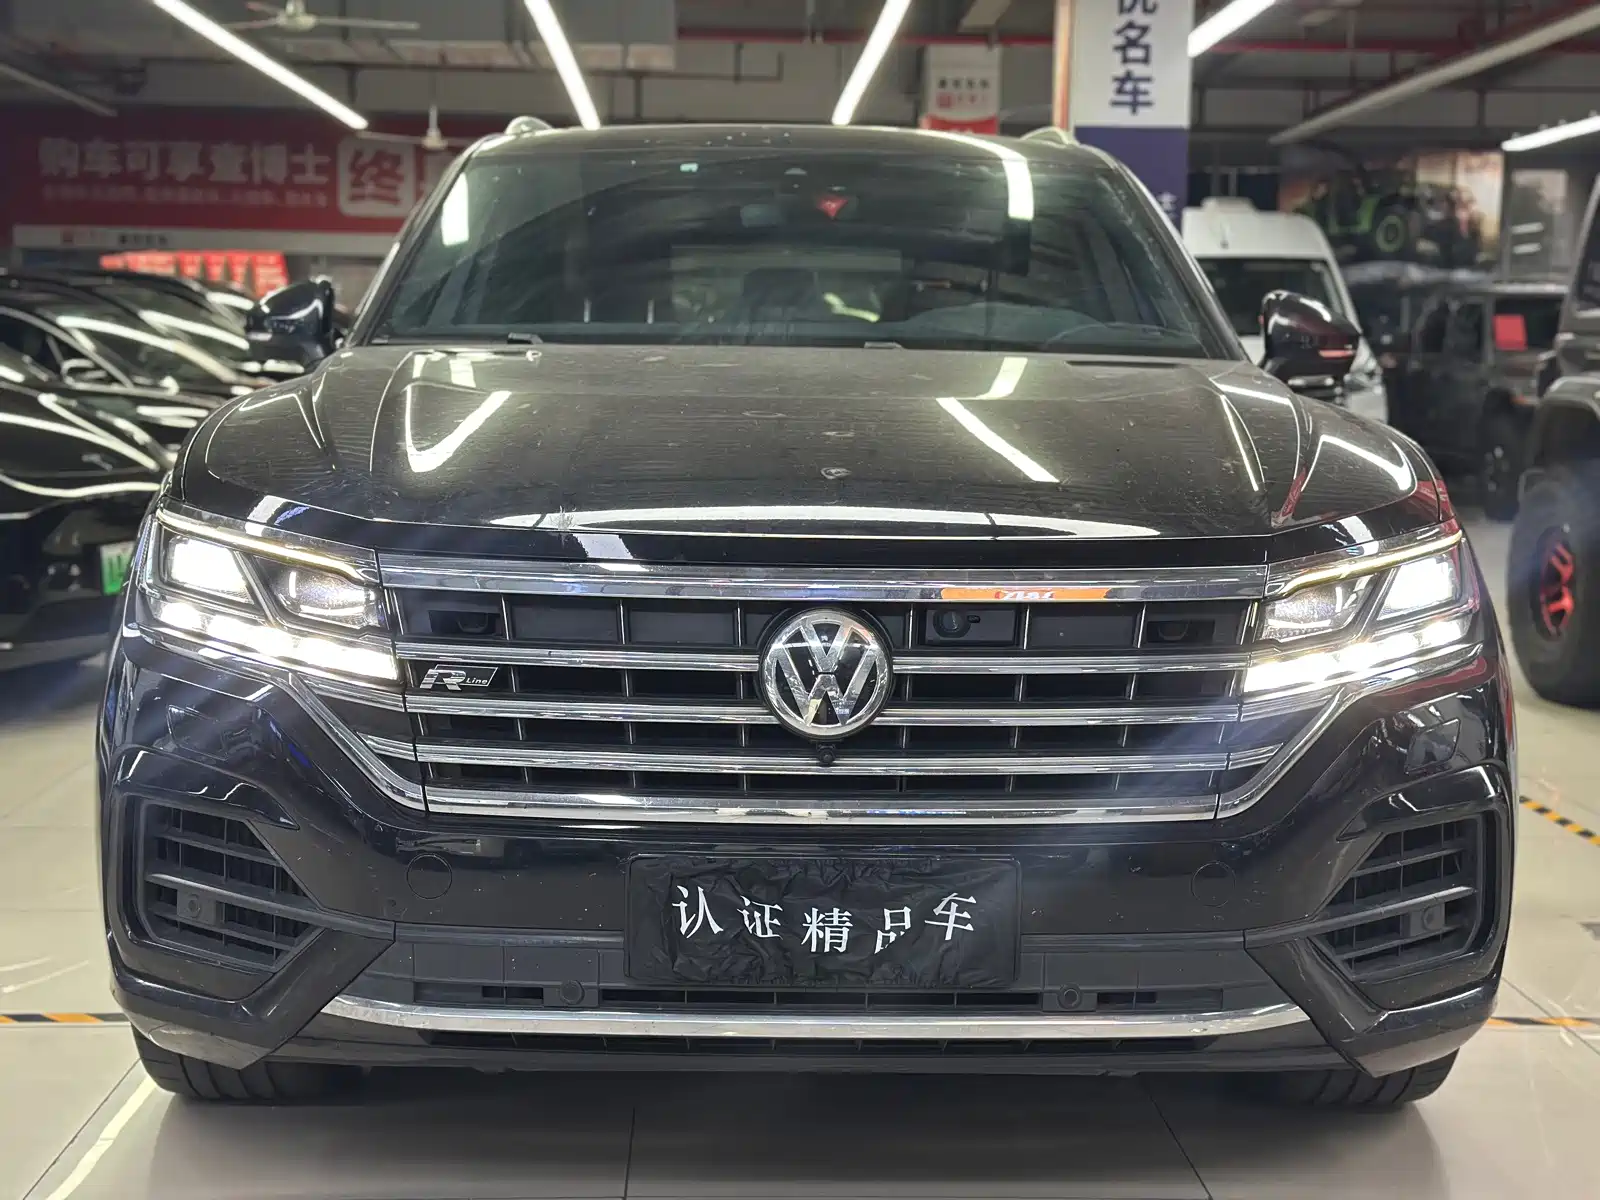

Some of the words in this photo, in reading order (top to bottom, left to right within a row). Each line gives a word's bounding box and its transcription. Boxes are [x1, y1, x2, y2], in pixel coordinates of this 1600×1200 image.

[671, 884, 977, 954] 认证精品车
